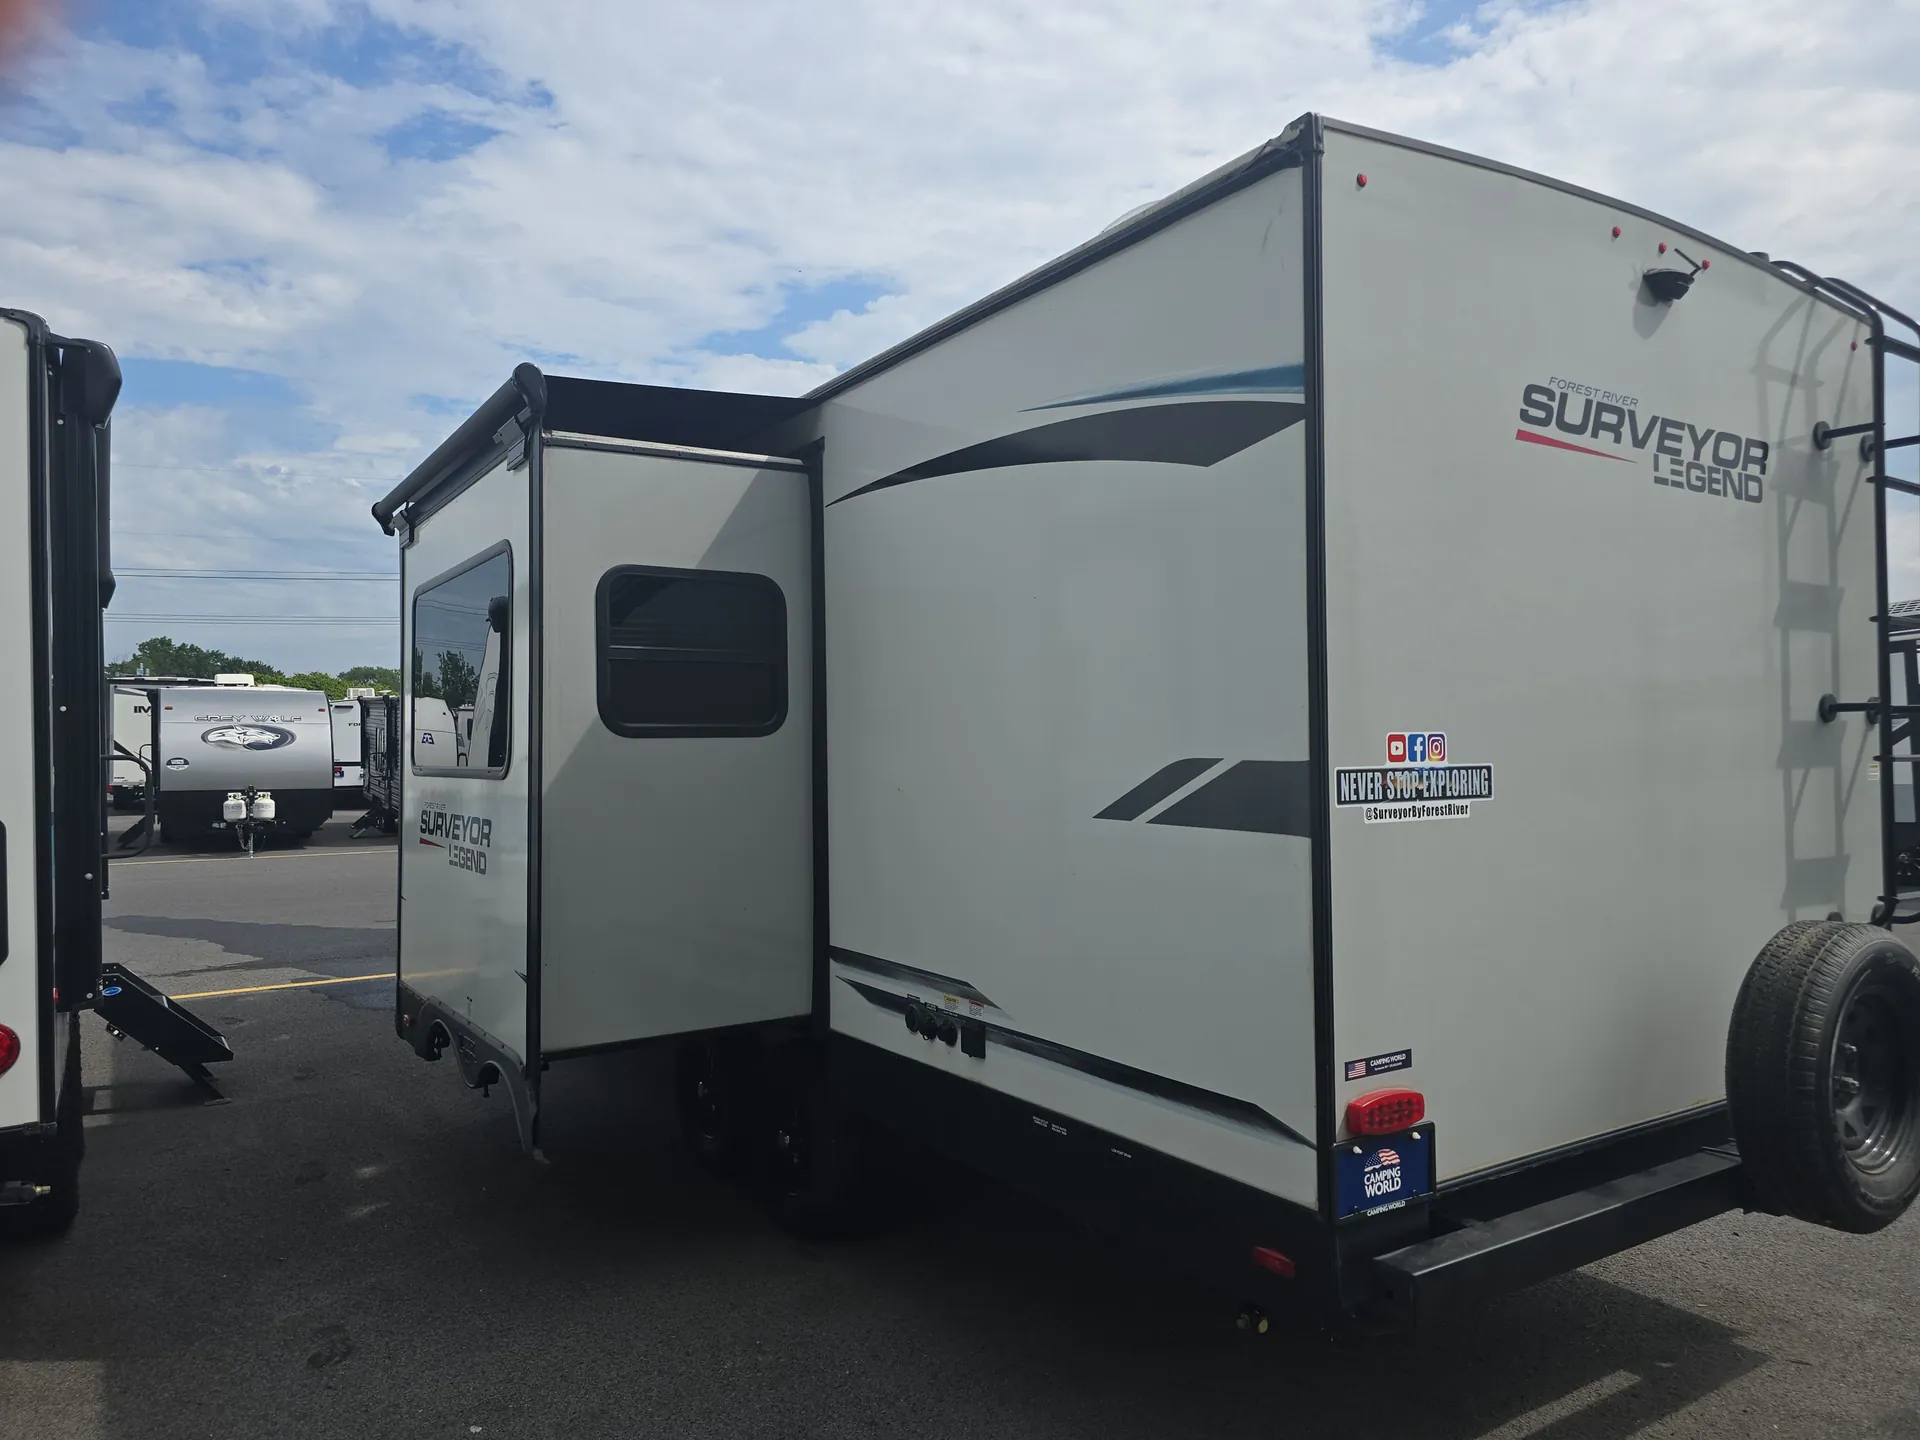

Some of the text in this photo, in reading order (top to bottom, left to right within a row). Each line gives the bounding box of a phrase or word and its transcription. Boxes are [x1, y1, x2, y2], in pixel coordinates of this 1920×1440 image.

[1548, 376, 1639, 408] FOREST RIVER
[1519, 383, 1770, 475] SURVEYOR
[1653, 453, 1763, 504] LEGEND
[193, 714, 246, 722] GREY
[1340, 768, 1489, 802] NEVER STOP EXPLORING
[1365, 803, 1469, 821] @SurveyorByForestRiver
[420, 809, 492, 848] SURVEYOR
[448, 844, 487, 875] LEGEND
[1370, 1056, 1391, 1067] CAMPING
[1390, 1053, 1407, 1063] WORLD
[1364, 1166, 1401, 1185] CAMPING
[1364, 1177, 1402, 1199] WORLD
[1366, 1200, 1406, 1217] CAMPING WORLD
